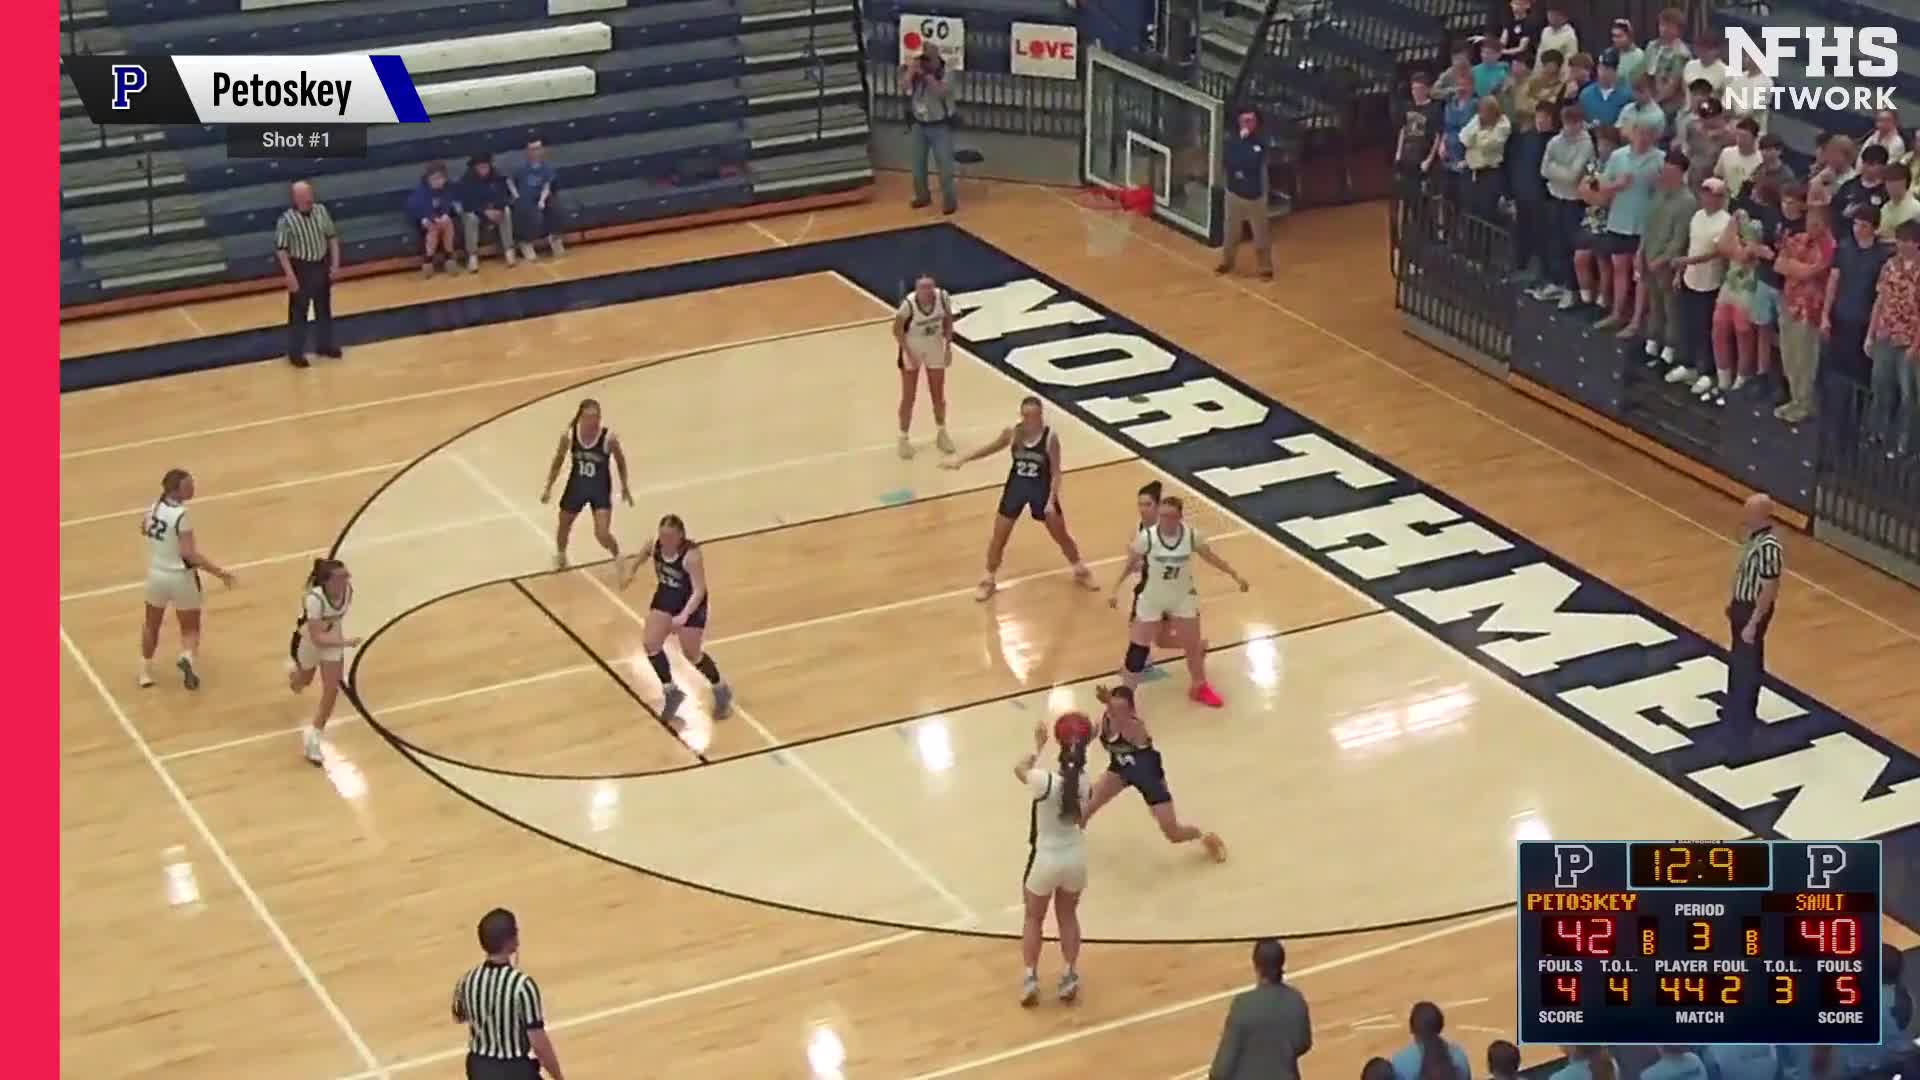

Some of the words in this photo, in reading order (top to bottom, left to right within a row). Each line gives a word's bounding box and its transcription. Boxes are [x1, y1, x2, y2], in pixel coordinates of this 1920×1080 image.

[920, 19, 949, 39] GO
[1016, 39, 1074, 60] LOVE
[578, 461, 596, 478] 10
[1016, 461, 1038, 477] 22
[954, 279, 1920, 840] NORTHMEN
